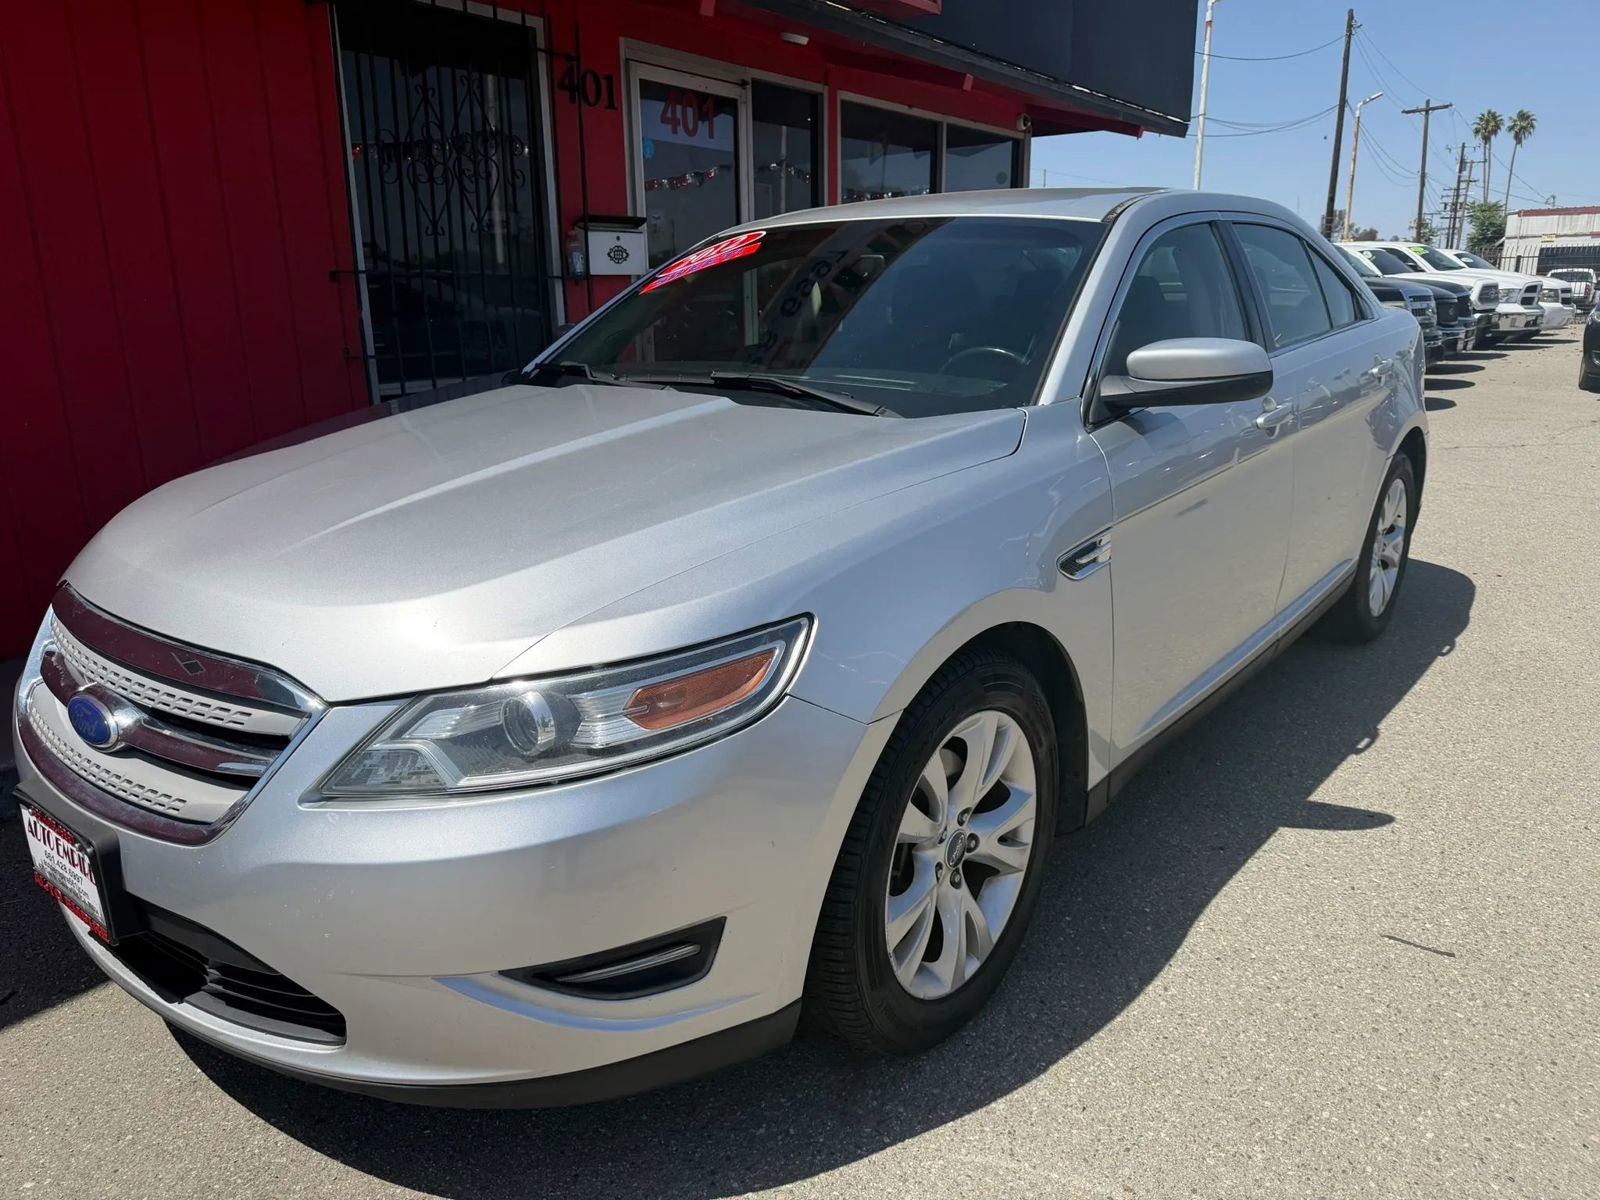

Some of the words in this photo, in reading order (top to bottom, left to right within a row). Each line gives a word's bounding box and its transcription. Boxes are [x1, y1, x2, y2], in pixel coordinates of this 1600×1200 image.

[560, 63, 617, 109] 401
[661, 92, 715, 139] 401
[27, 815, 54, 852] AUTO
